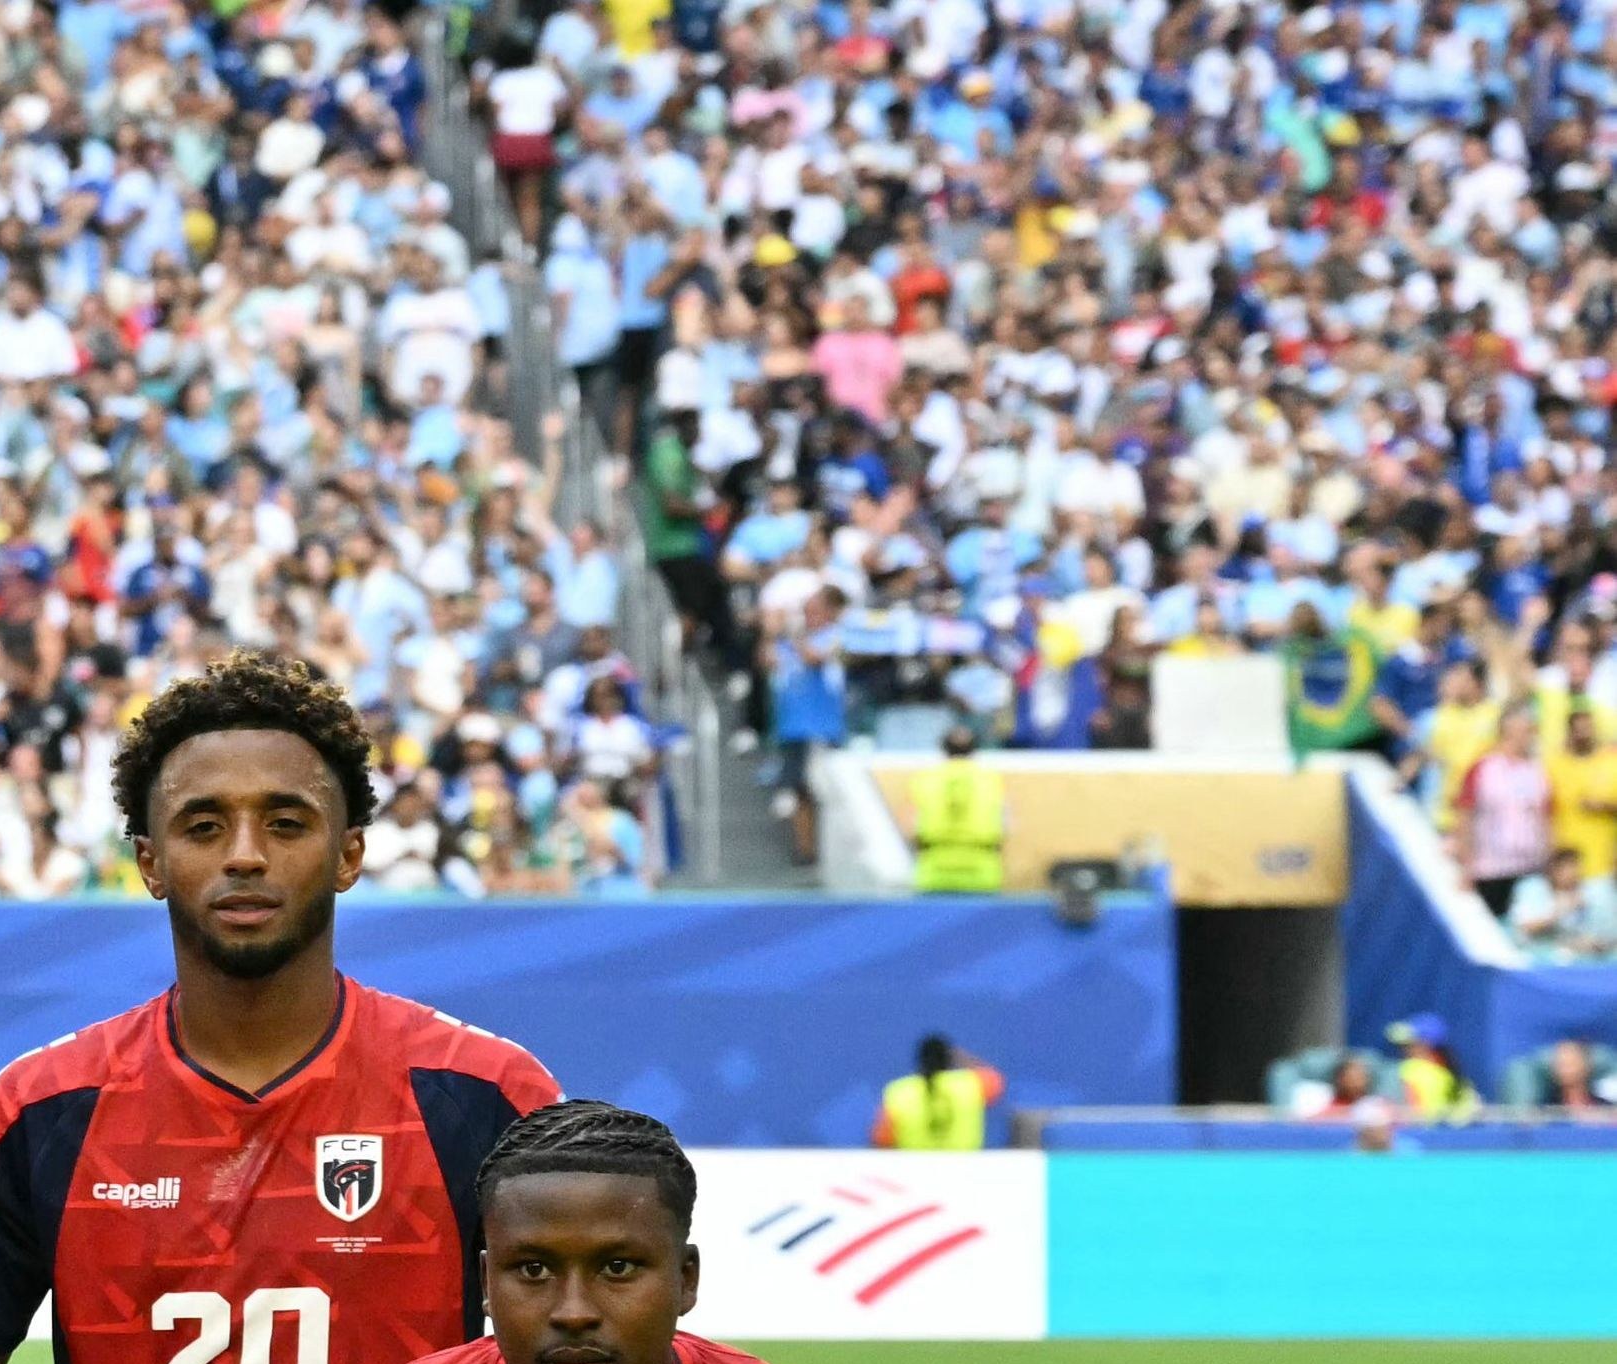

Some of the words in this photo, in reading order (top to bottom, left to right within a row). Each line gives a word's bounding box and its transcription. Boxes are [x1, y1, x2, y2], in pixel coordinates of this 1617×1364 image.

[323, 1139, 377, 1153] FCF
[91, 1176, 182, 1207] capelli
[129, 1199, 180, 1210] SPORT
